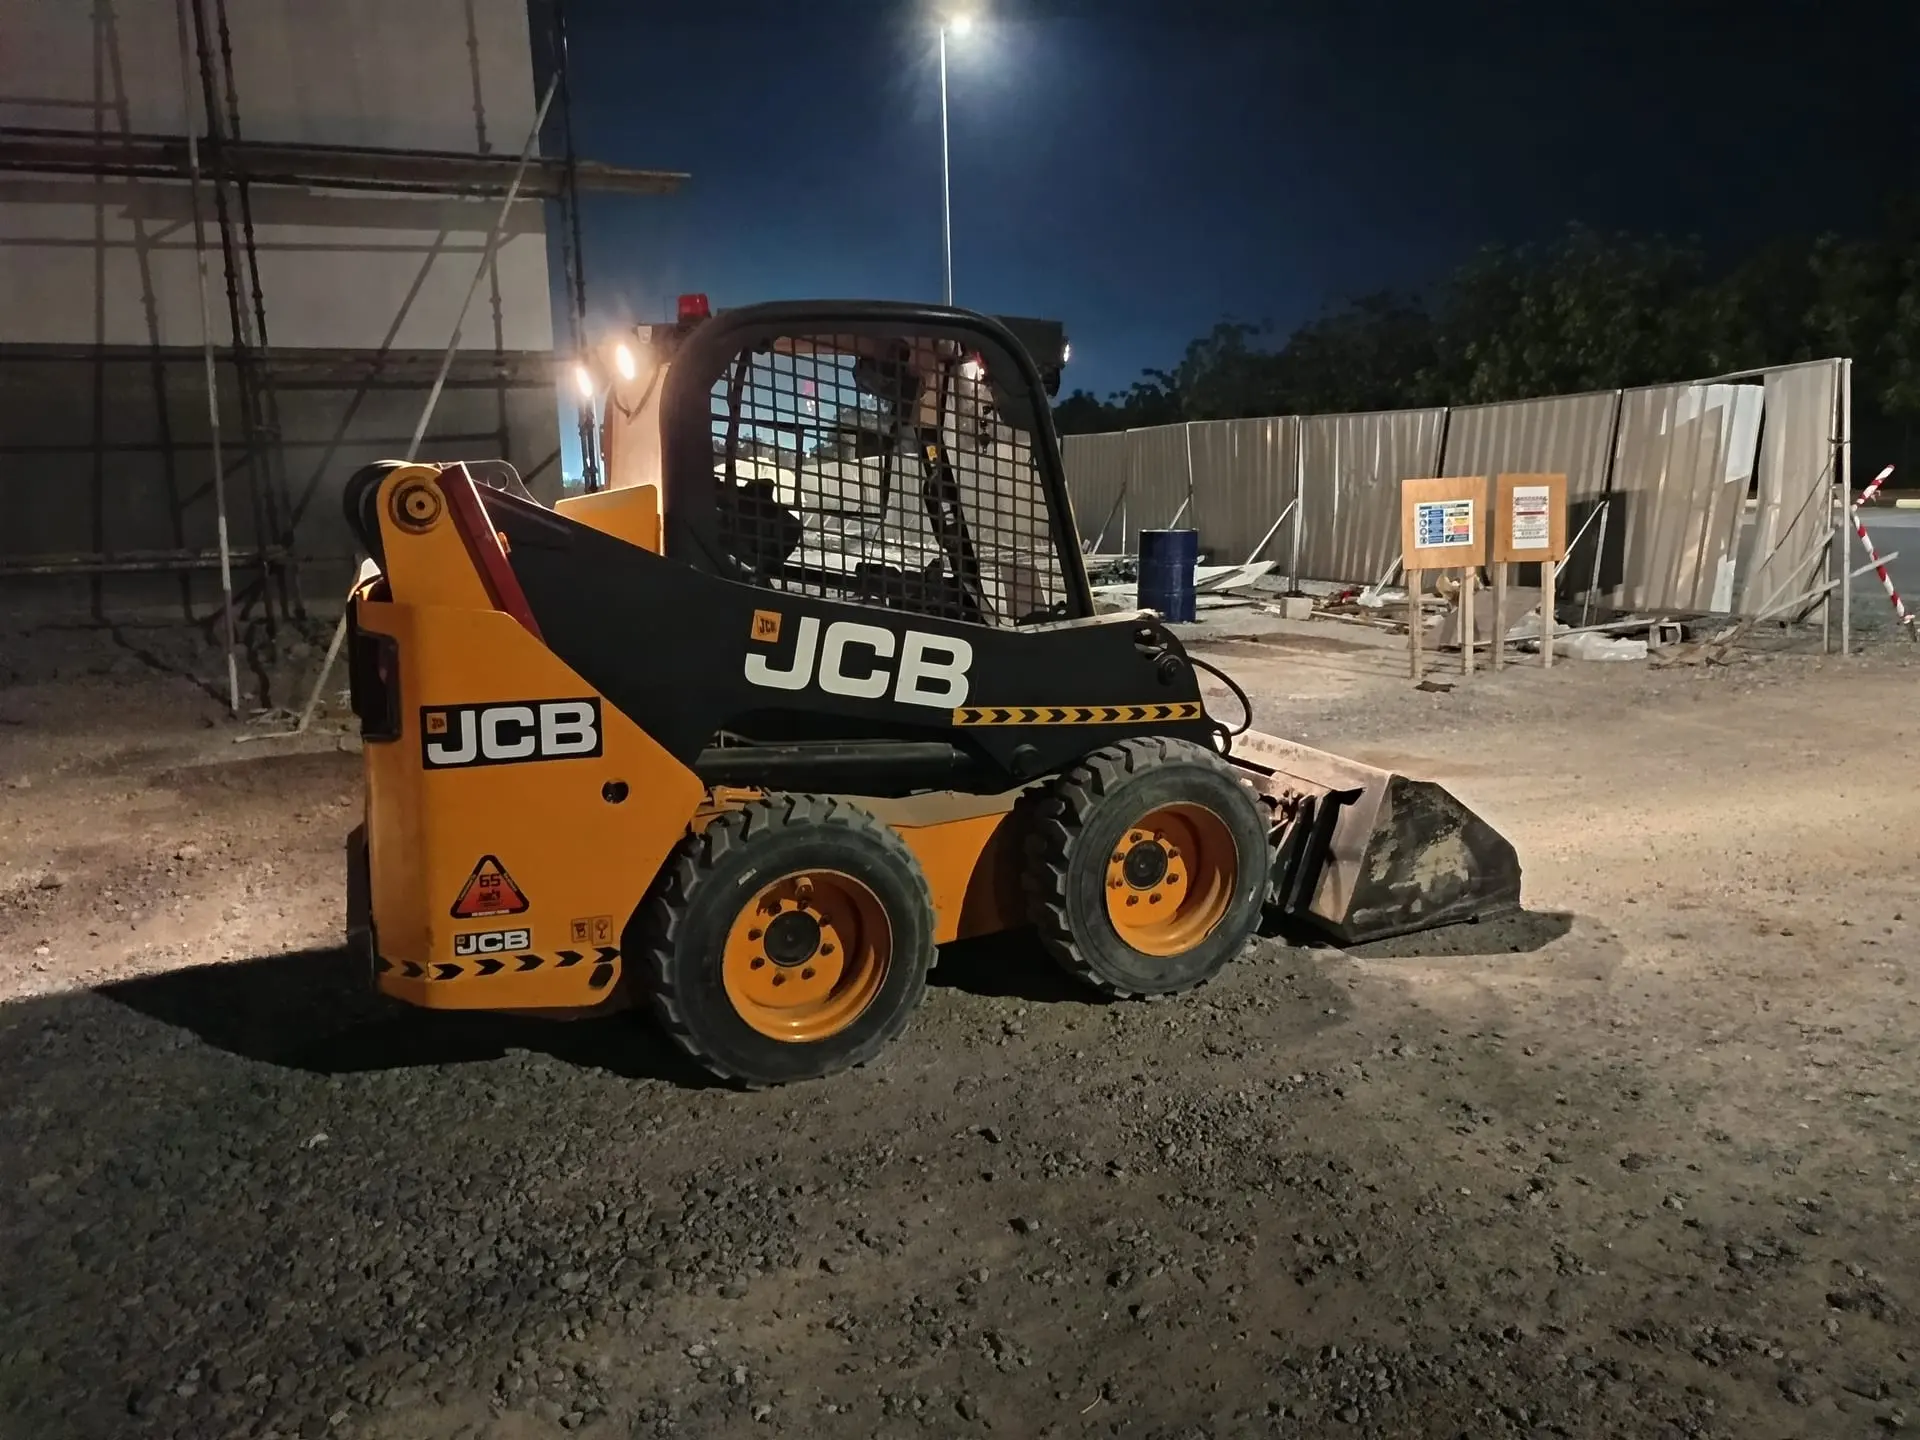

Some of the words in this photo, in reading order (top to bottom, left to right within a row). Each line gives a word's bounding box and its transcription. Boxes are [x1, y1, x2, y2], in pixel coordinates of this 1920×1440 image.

[744, 616, 973, 709] JCB
[427, 702, 597, 765] JCB
[456, 930, 528, 954] JCB
